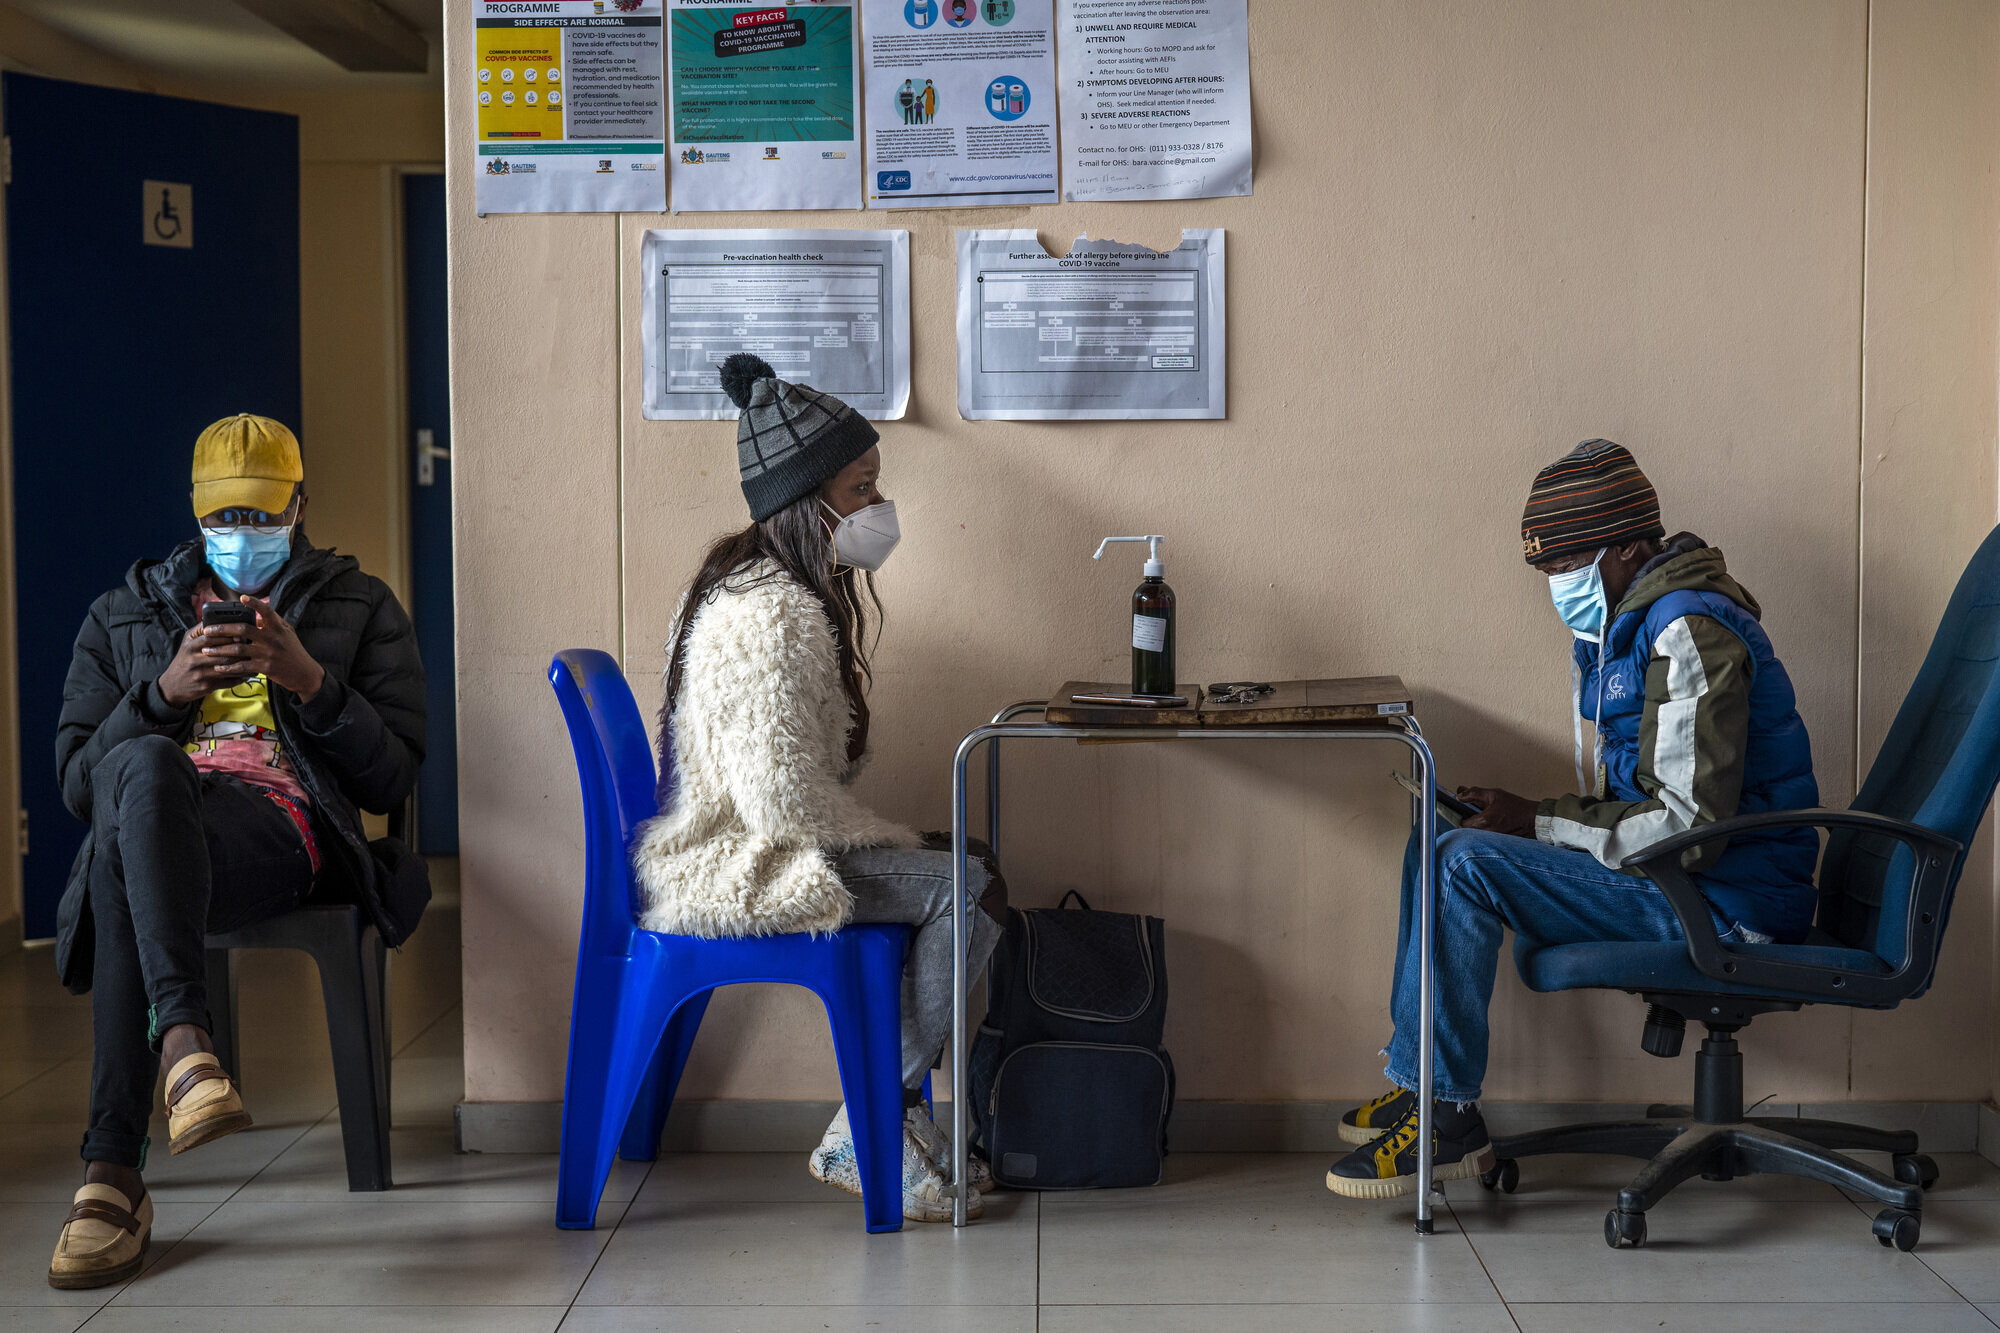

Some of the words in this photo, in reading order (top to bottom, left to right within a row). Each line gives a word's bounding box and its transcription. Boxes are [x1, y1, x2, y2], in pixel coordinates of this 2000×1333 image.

[486, 3, 560, 13] PROGRAMME
[588, 18, 625, 26] NORMAL
[735, 16, 754, 25] KEY
[756, 11, 785, 23] FACTS
[733, 29, 756, 37] KNOW
[757, 25, 781, 34] ABOUT
[1075, 25, 1083, 33] 1)
[1085, 24, 1115, 32] UNWELL
[1133, 22, 1164, 30] REQUIRE
[719, 38, 753, 47] COVID-19
[753, 30, 801, 42] VACCINATION
[1085, 35, 1126, 43] ATTENTION
[643, 40, 658, 48] they
[738, 41, 785, 53] PROGRAMME
[1097, 47, 1122, 55] Working
[572, 66, 604, 74] managed
[1077, 80, 1084, 88] 2)
[1086, 79, 1127, 87] SYMPTOMS
[1128, 77, 1173, 85] DEVELOPING
[1197, 75, 1225, 83] HOURS:
[1175, 88, 1190, 96] (who
[1159, 121, 1193, 129] Emergency
[1149, 144, 1167, 153] (011)
[1168, 143, 1200, 151] 933-0328
[1101, 159, 1111, 167] for
[1112, 159, 1129, 167] OHS:
[1132, 157, 1216, 166] bara.vaccine@gmail.com
[948, 173, 1053, 182] www.cdc.gov/coronavirus/vaccines
[778, 253, 801, 261] health
[802, 253, 824, 261] check
[1008, 252, 1035, 260] Further
[1083, 252, 1108, 260] allergy
[1133, 252, 1156, 260] giving
[1606, 692, 1626, 700] CUTTY
